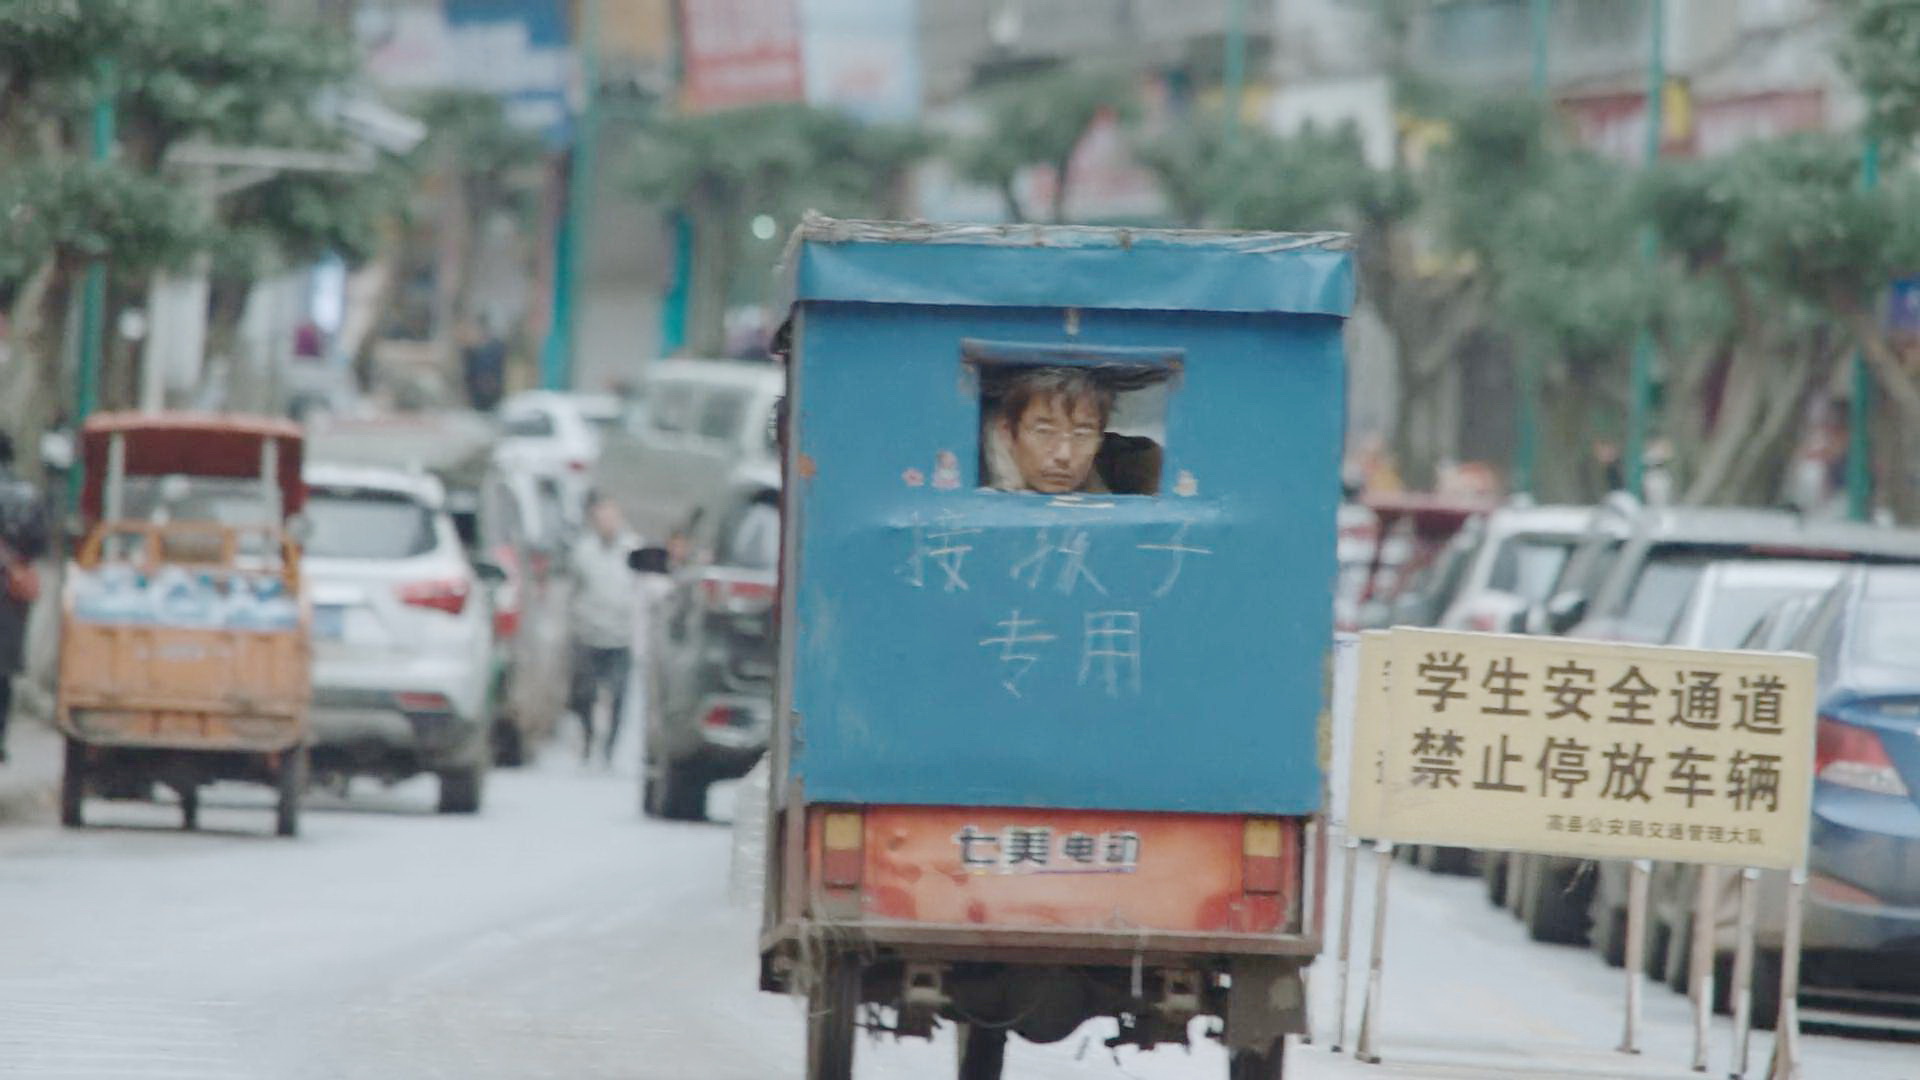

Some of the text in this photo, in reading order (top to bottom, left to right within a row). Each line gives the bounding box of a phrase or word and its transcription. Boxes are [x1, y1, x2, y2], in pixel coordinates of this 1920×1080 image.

[979, 609, 1141, 698] 专用
[1415, 652, 1788, 735] 学生安全通道
[1410, 727, 1784, 813] 禁止停放车辆
[1545, 814, 1765, 845] 高县公安局交通管理大队
